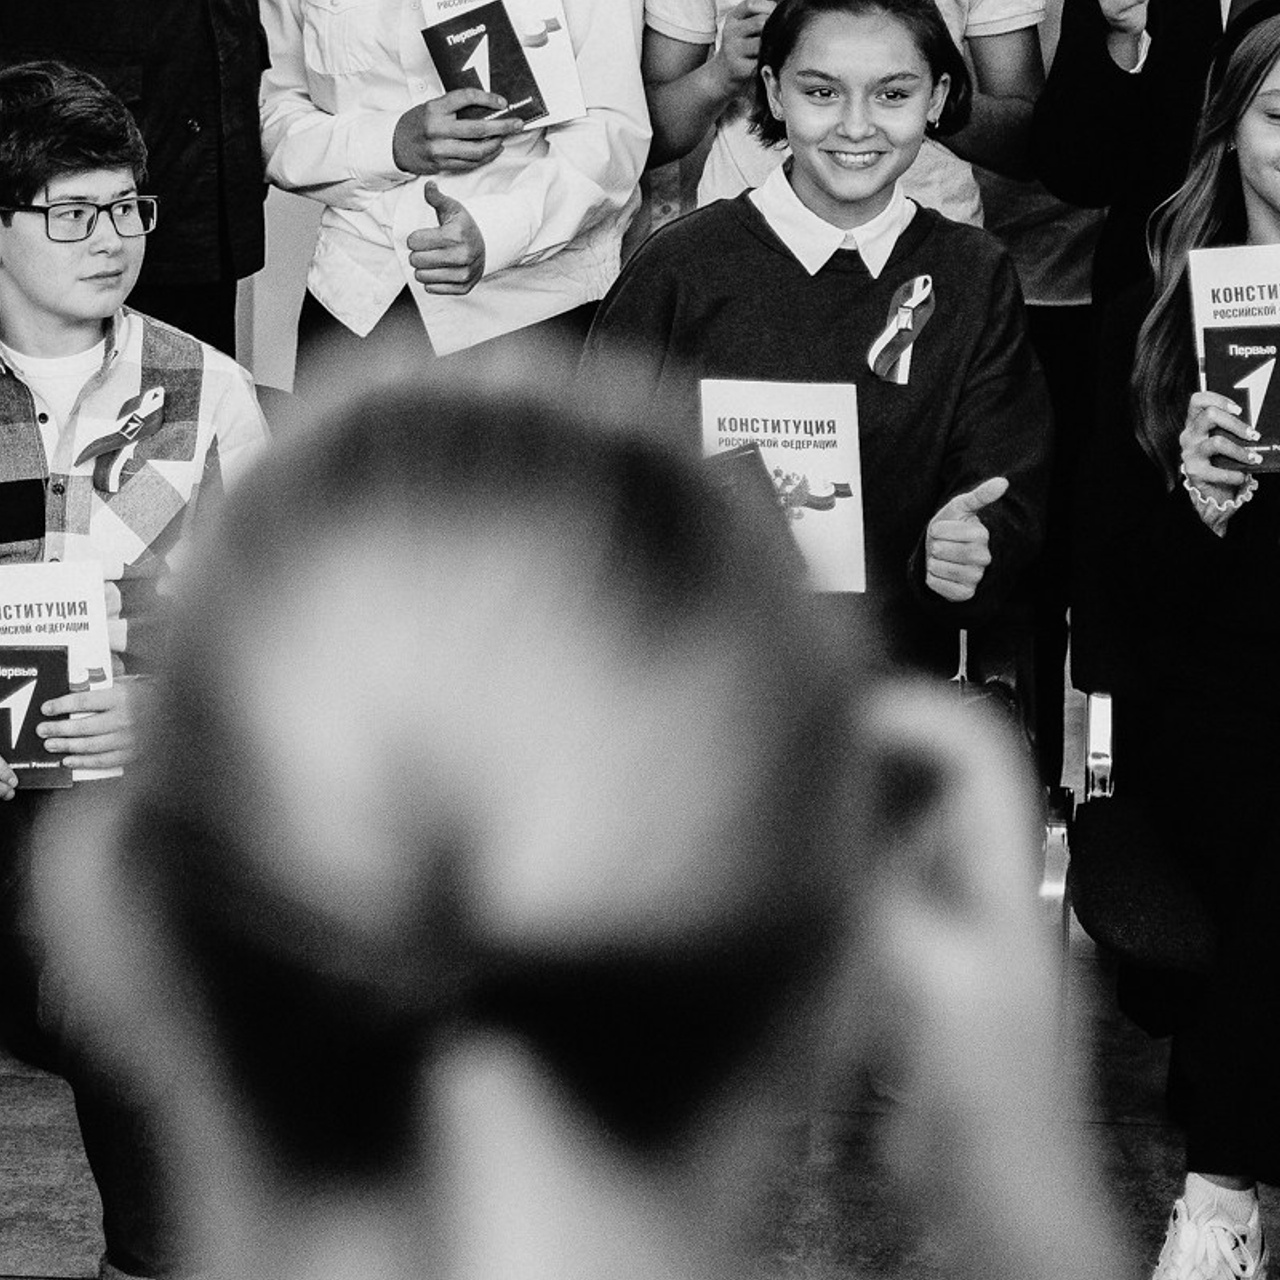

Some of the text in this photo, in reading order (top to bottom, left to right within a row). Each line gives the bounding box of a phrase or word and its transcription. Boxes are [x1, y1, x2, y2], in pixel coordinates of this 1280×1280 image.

[1211, 284, 1280, 304] КОНСТИ
[1212, 304, 1277, 320] РОССИЙСКОЙ
[1228, 344, 1277, 358] Первые
[717, 417, 837, 437] КОНСТИТУЦИЯ
[780, 439, 838, 451] ФЕДЕРАЦИИ
[35, 621, 89, 635] ФЕДЕРАЦИИ
